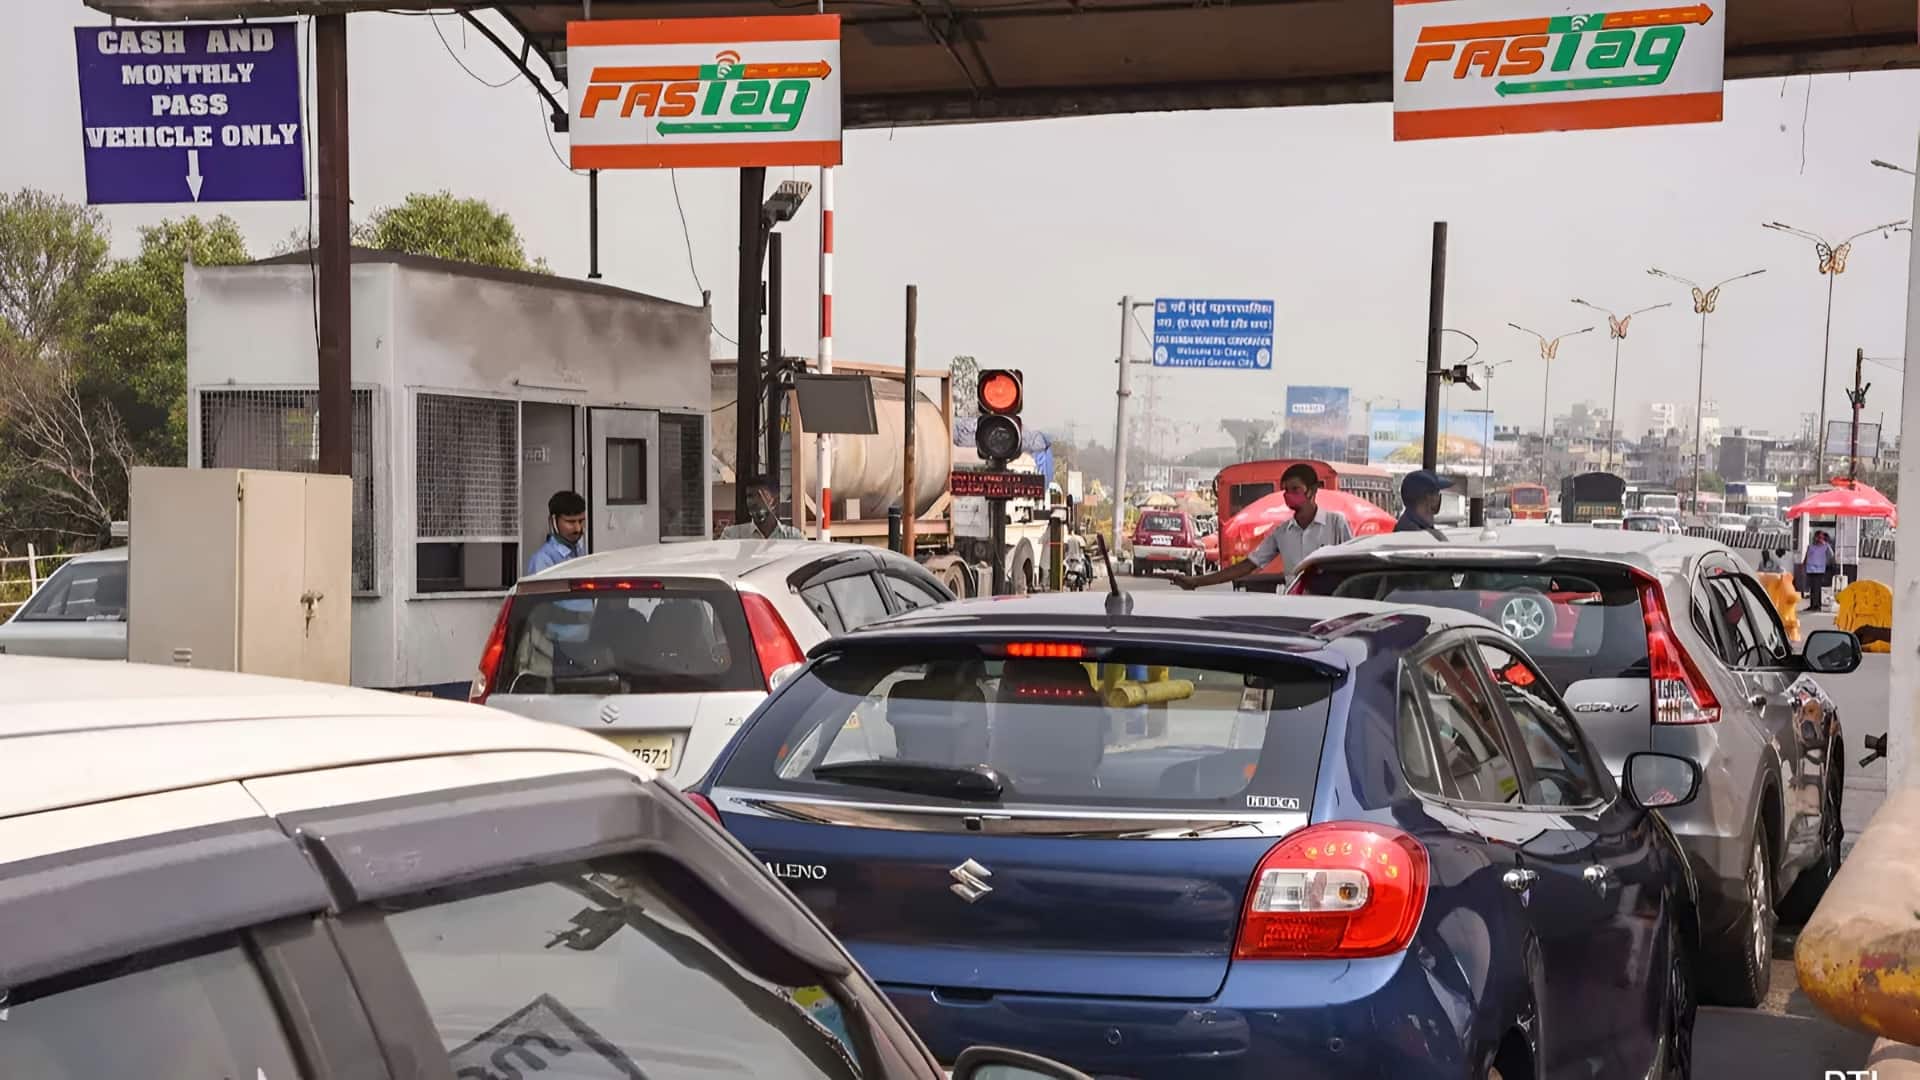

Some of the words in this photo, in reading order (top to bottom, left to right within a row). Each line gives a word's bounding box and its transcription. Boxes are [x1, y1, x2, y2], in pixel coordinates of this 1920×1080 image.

[98, 29, 186, 55] CASH
[206, 28, 274, 53] AND
[1404, 13, 1687, 86] FASTag
[121, 63, 254, 85] MONTHLY
[151, 93, 229, 116] PASS
[579, 63, 812, 133] FASTag
[85, 126, 213, 148] VEHICLE
[221, 123, 298, 146] ONLY
